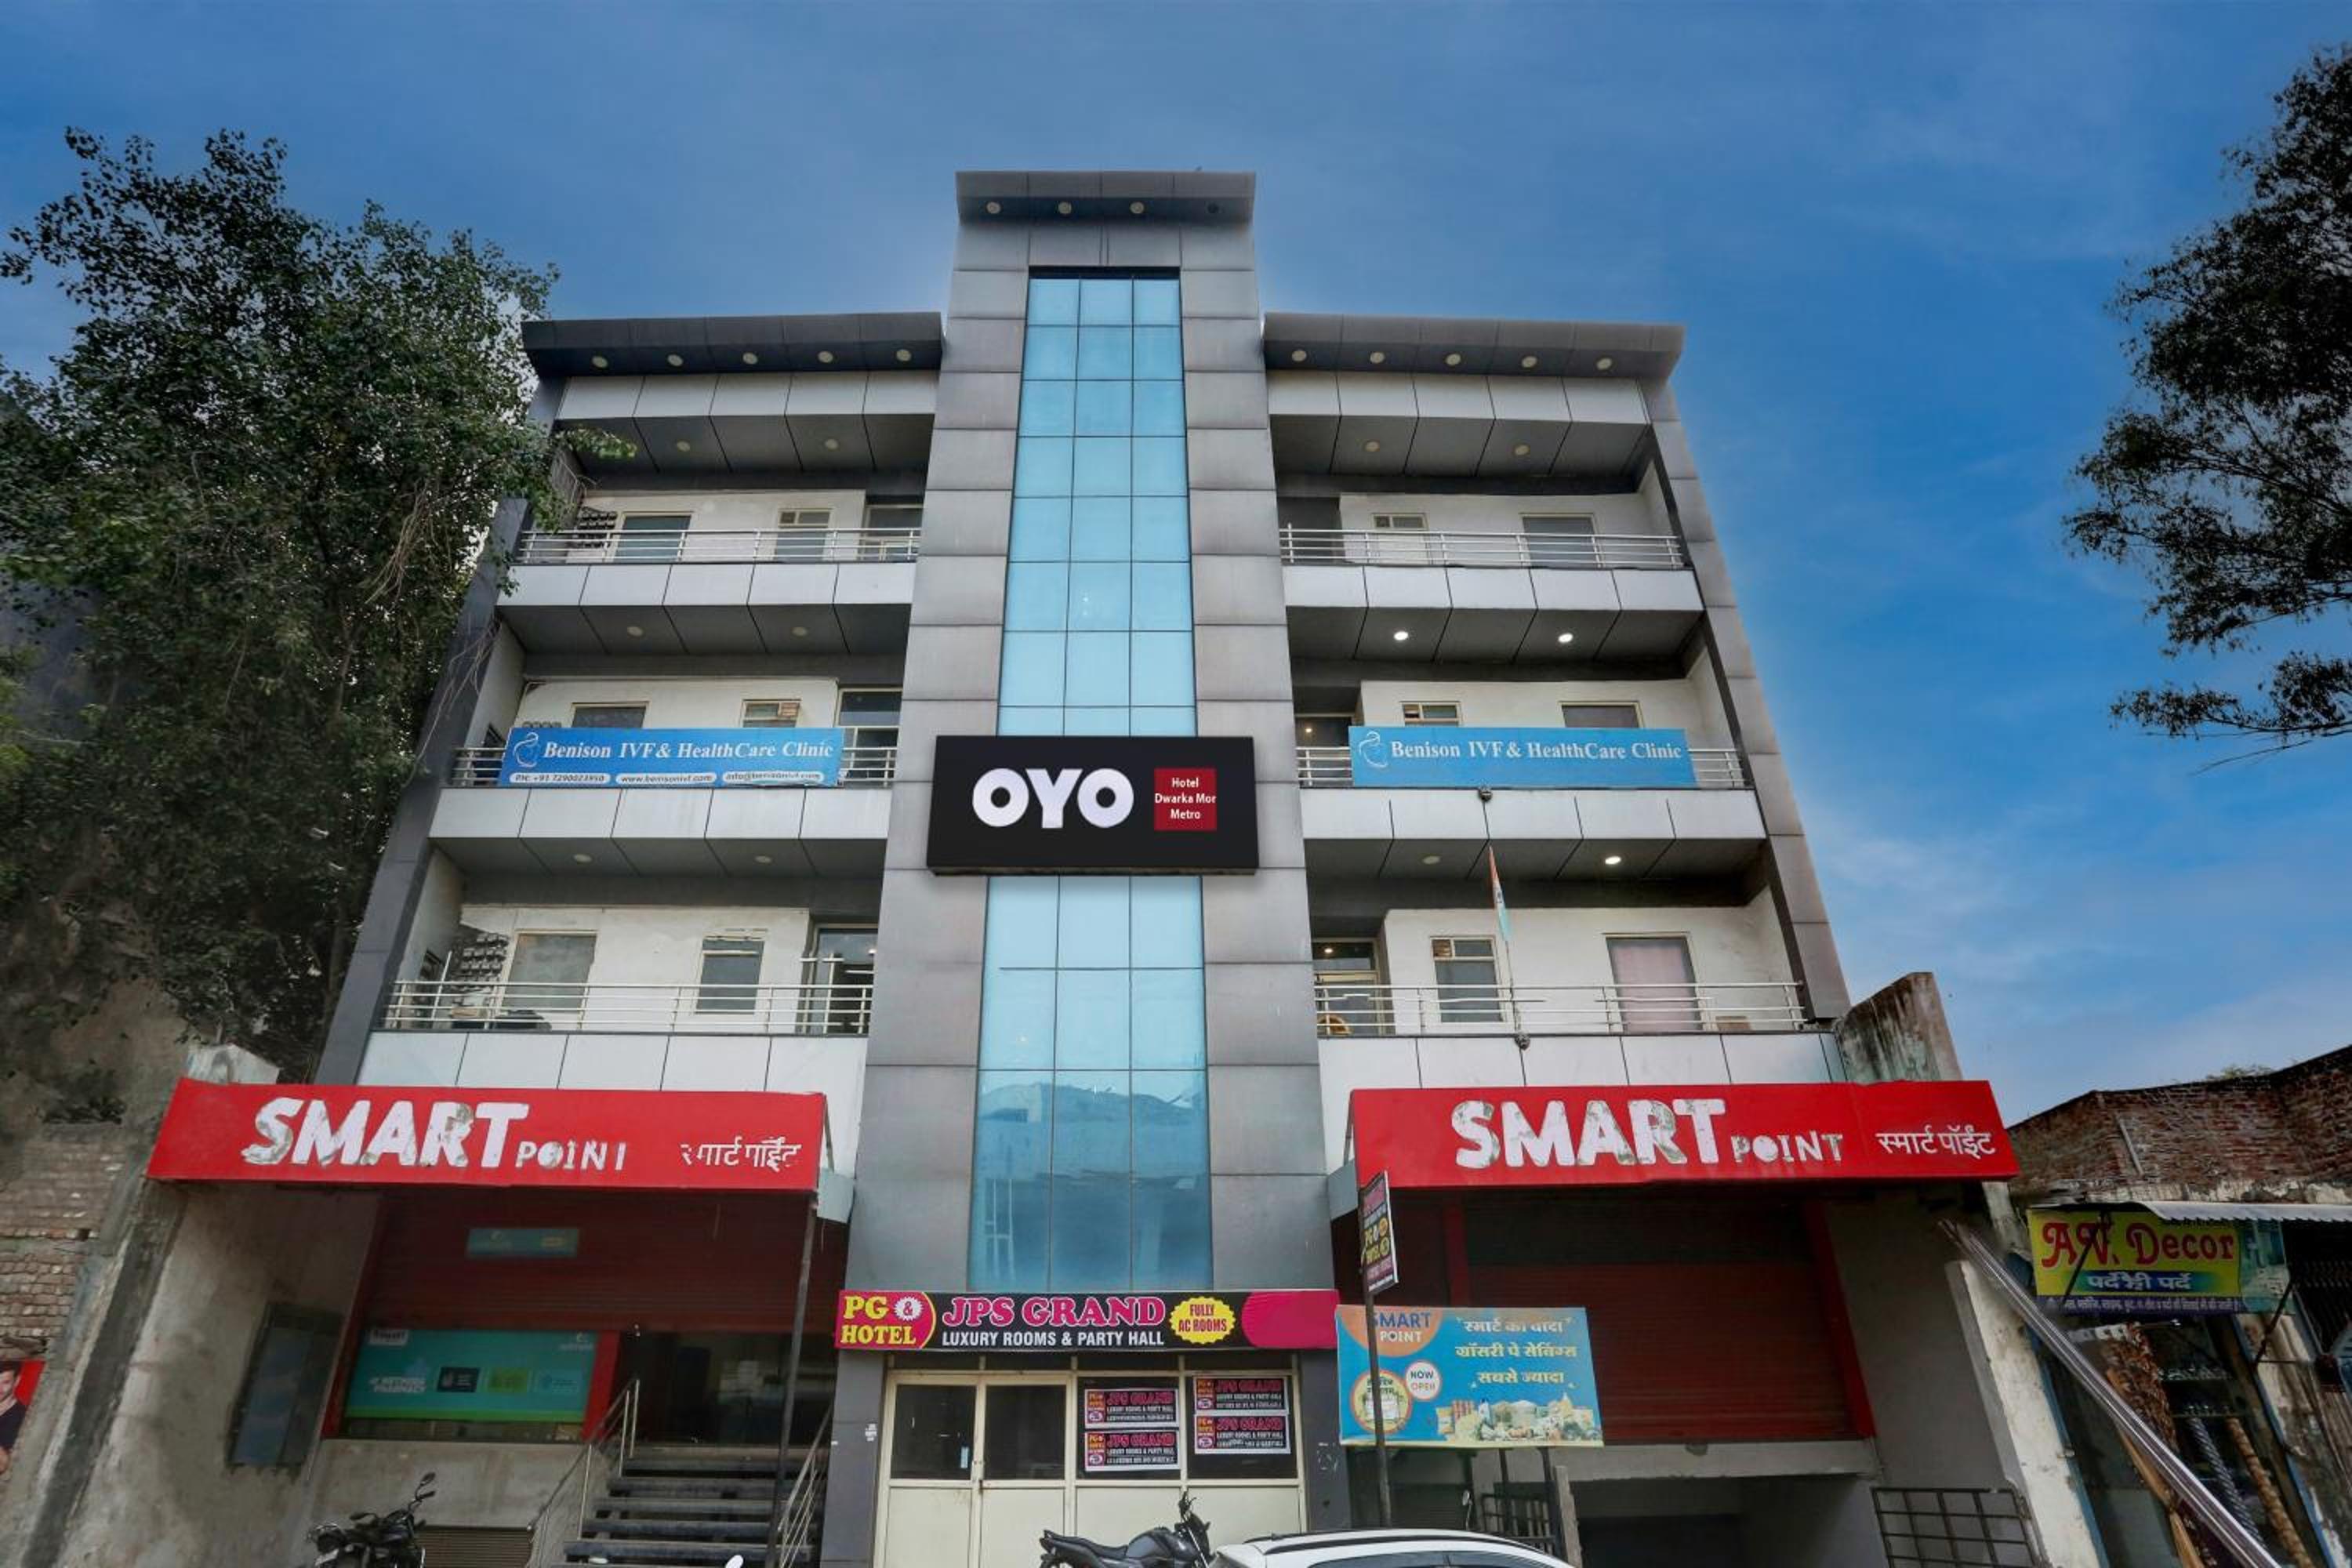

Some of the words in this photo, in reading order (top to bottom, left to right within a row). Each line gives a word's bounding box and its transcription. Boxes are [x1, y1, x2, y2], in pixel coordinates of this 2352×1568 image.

[543, 742, 611, 758] Benison
[620, 742, 656, 758] IVF
[655, 742, 671, 758] &
[677, 742, 776, 759] HealthCare
[782, 741, 833, 757] Clinic
[1392, 741, 1461, 758] Benison
[1469, 741, 1503, 757] IVF
[1506, 743, 1521, 757] &
[1527, 742, 1626, 759] HealthCare
[1632, 742, 1682, 758] Clinic
[1172, 777, 1199, 788] Hotel
[972, 768, 1134, 829] OYO
[1155, 792, 1194, 804] Dwarka
[1171, 808, 1201, 819] Metro
[241, 1097, 529, 1167] SMART
[1451, 1098, 1725, 1168] SMART
[1730, 1130, 1843, 1163] POINT
[2125, 1222, 2234, 1265] Decor
[844, 1295, 889, 1319] PG
[902, 1301, 914, 1316] &
[942, 1296, 1014, 1327] JPS
[1022, 1296, 1166, 1327] GRAND
[1189, 1304, 1214, 1316] FULLY
[1178, 1319, 1191, 1332] AC
[1192, 1318, 1227, 1332] ROOMS
[1374, 1312, 1431, 1328] MART
[840, 1324, 916, 1345] HOTEL
[942, 1331, 999, 1346] LUXURY
[1003, 1331, 1057, 1346] ROOMS
[1061, 1331, 1074, 1346] &
[1077, 1330, 1123, 1346] PARTY
[1127, 1330, 1164, 1345] HALL
[1410, 1370, 1434, 1379] NOW
